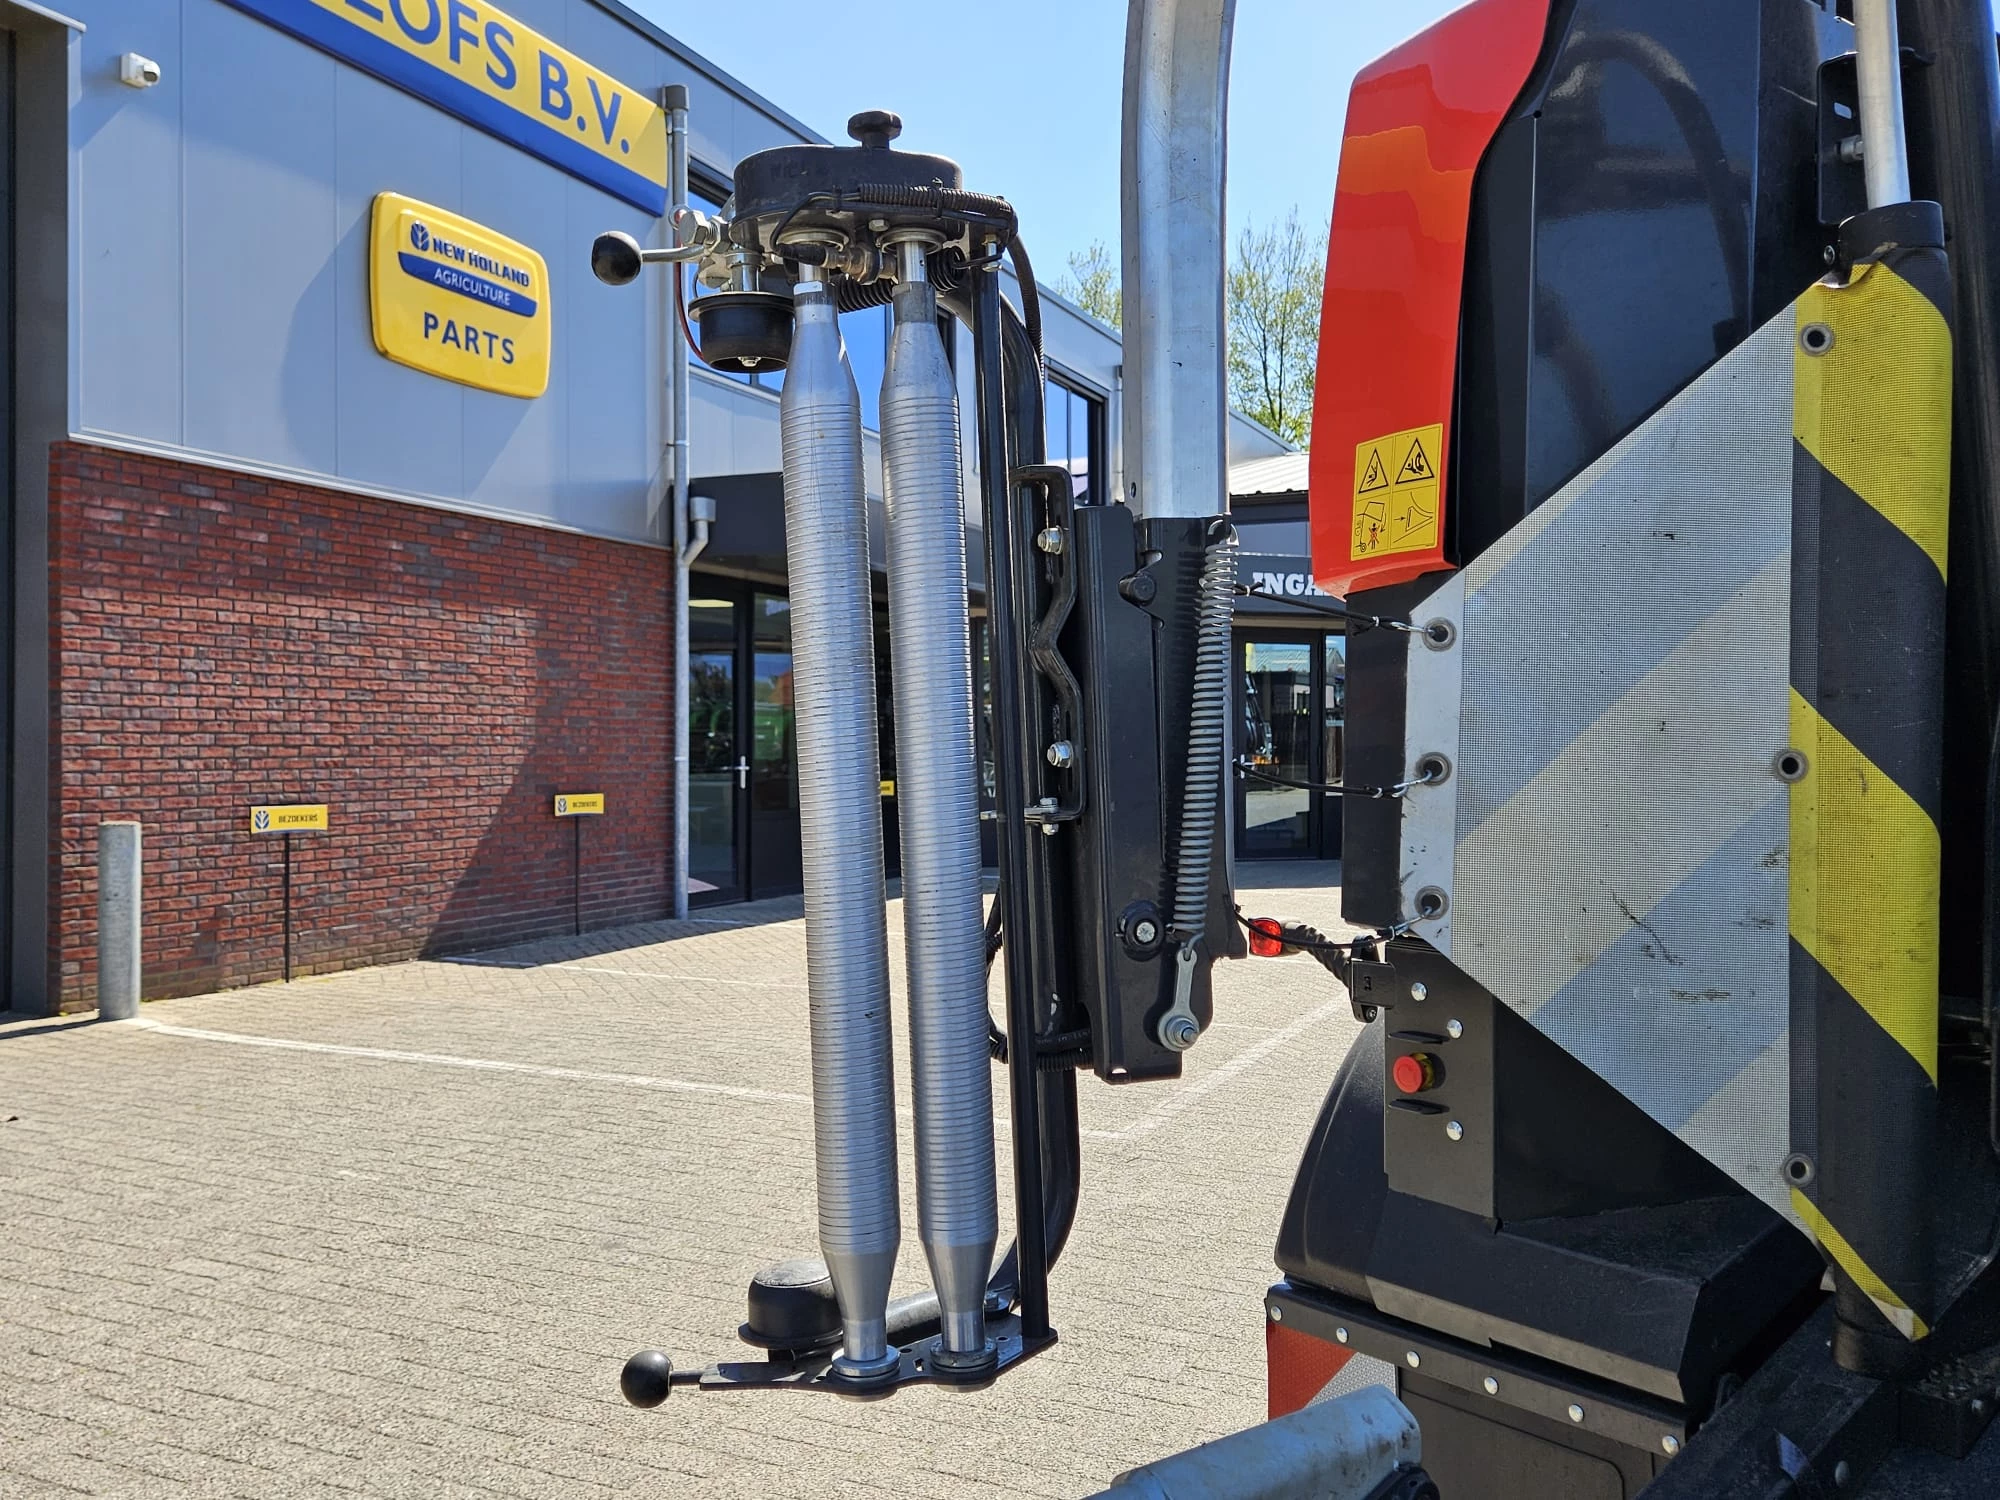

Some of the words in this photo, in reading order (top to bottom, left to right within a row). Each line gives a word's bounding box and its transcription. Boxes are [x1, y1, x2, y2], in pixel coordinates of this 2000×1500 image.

[345, 0, 516, 90] OFS
[539, 50, 630, 154] B.V.
[432, 237, 465, 263] NEW
[468, 250, 530, 287] HOLLAND
[434, 267, 510, 306] AGRICULTURE
[424, 311, 514, 364] PARTS
